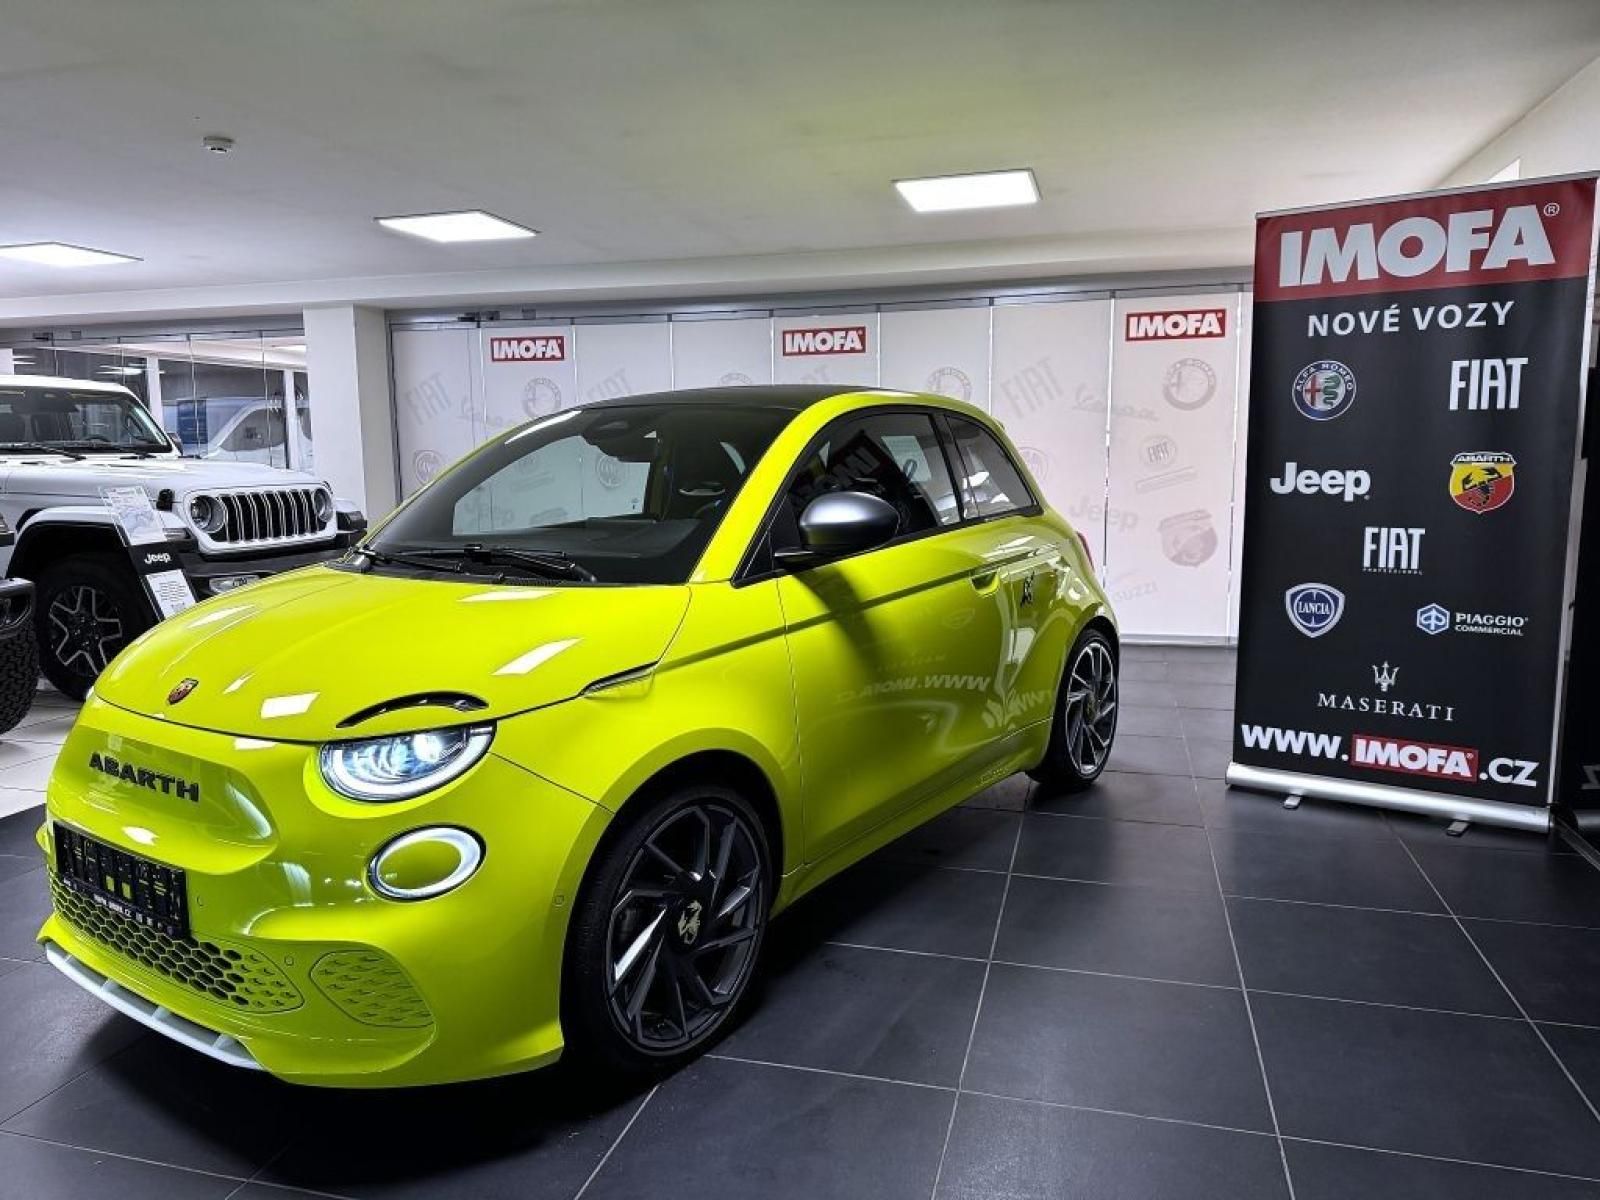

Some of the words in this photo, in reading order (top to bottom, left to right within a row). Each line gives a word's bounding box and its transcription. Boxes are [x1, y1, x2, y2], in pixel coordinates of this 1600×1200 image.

[1129, 311, 1222, 338] IMOFA
[1307, 303, 1401, 338] NOVÉ
[1412, 300, 1515, 331] VOZY
[493, 339, 562, 359] IMOFA
[785, 330, 863, 353] IMOFA
[1449, 357, 1529, 411] FIAT
[1270, 462, 1371, 502] Jeep
[144, 552, 172, 565] Jeep
[1363, 526, 1426, 570] FIAT
[1298, 601, 1331, 615] LANCIA
[1455, 612, 1525, 628] PIAGGIO
[1317, 692, 1456, 721] MASERATI
[88, 752, 200, 802] ABARTH
